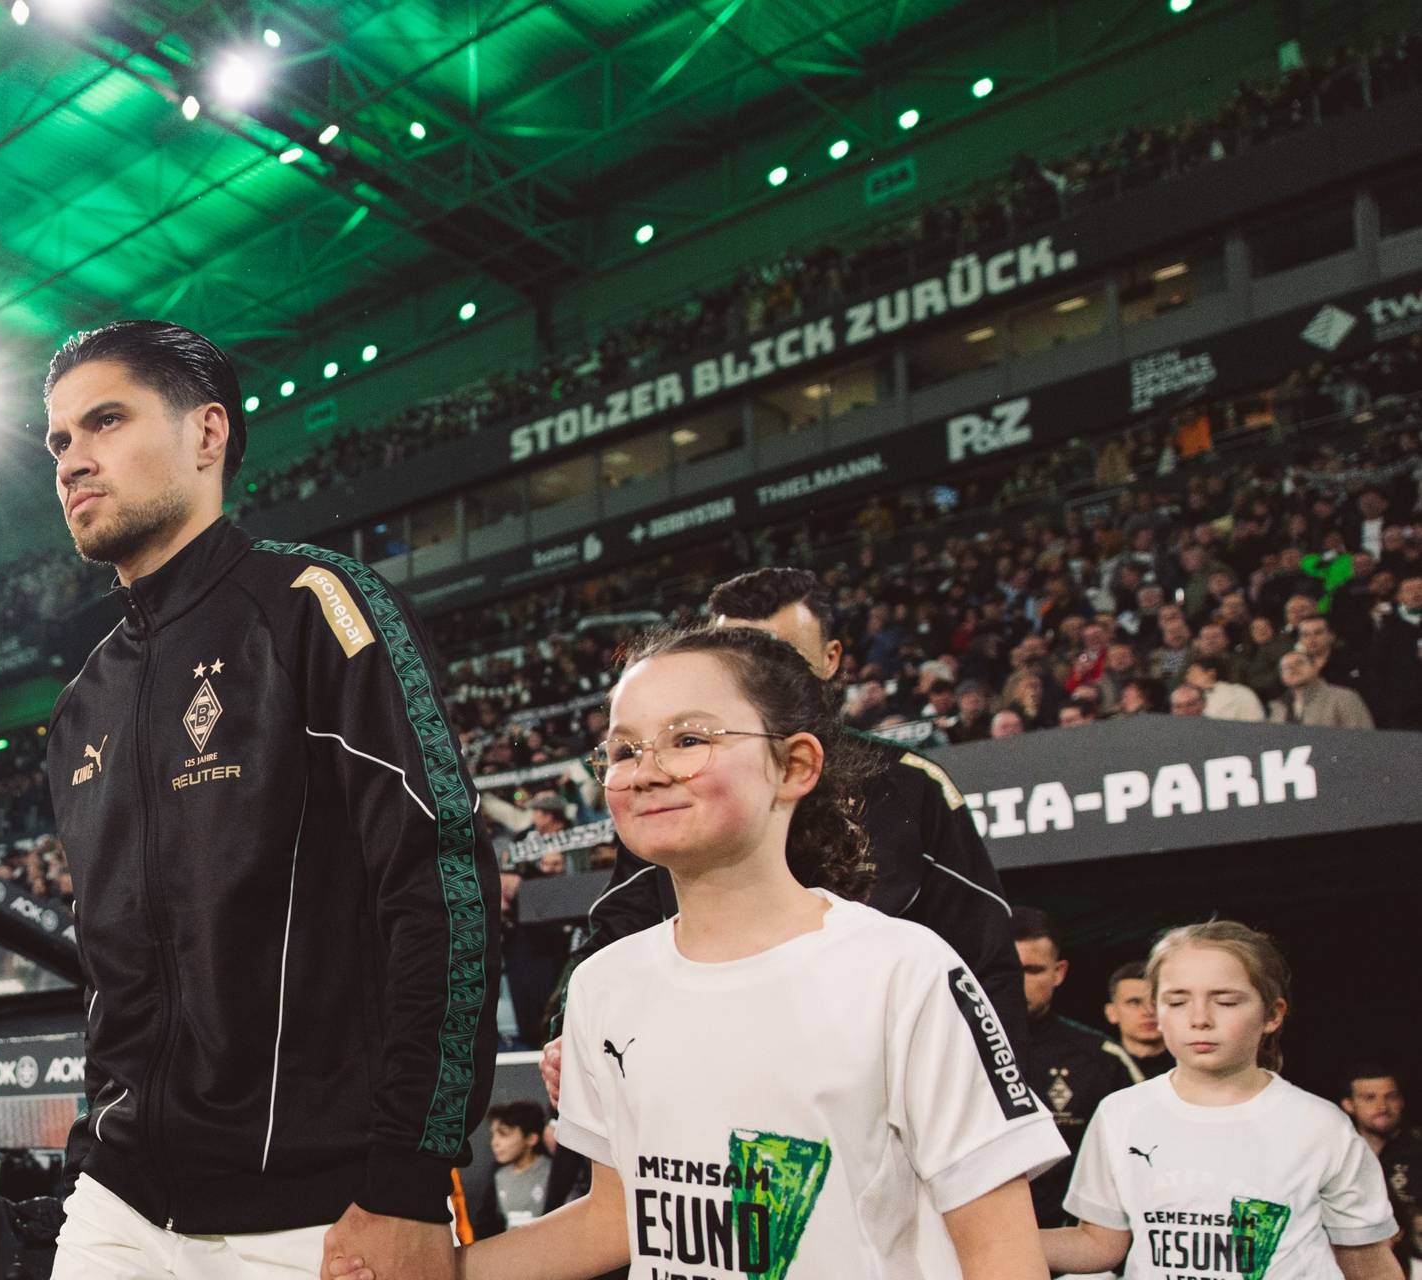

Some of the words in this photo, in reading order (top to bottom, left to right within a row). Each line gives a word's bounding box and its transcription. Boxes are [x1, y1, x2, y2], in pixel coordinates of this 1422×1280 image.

[509, 372, 685, 462] STOLZER
[693, 316, 837, 397] BLICK
[846, 235, 1078, 344] ZURÜCK.
[947, 397, 1032, 463] P&Z
[314, 576, 364, 645] sonepar
[72, 762, 94, 786] KING
[171, 765, 242, 791] REUTER
[184, 759, 196, 768] 125
[196, 752, 219, 766] JAHRE
[10, 896, 43, 924] AOK
[44, 1056, 86, 1083] AOK
[974, 1003, 1033, 1109] sonepar
[636, 1155, 770, 1192] MEINSAM
[635, 1188, 770, 1274] ESUND
[1144, 1211, 1256, 1230] GEMEINSAM
[1148, 1229, 1256, 1274] GESUND
